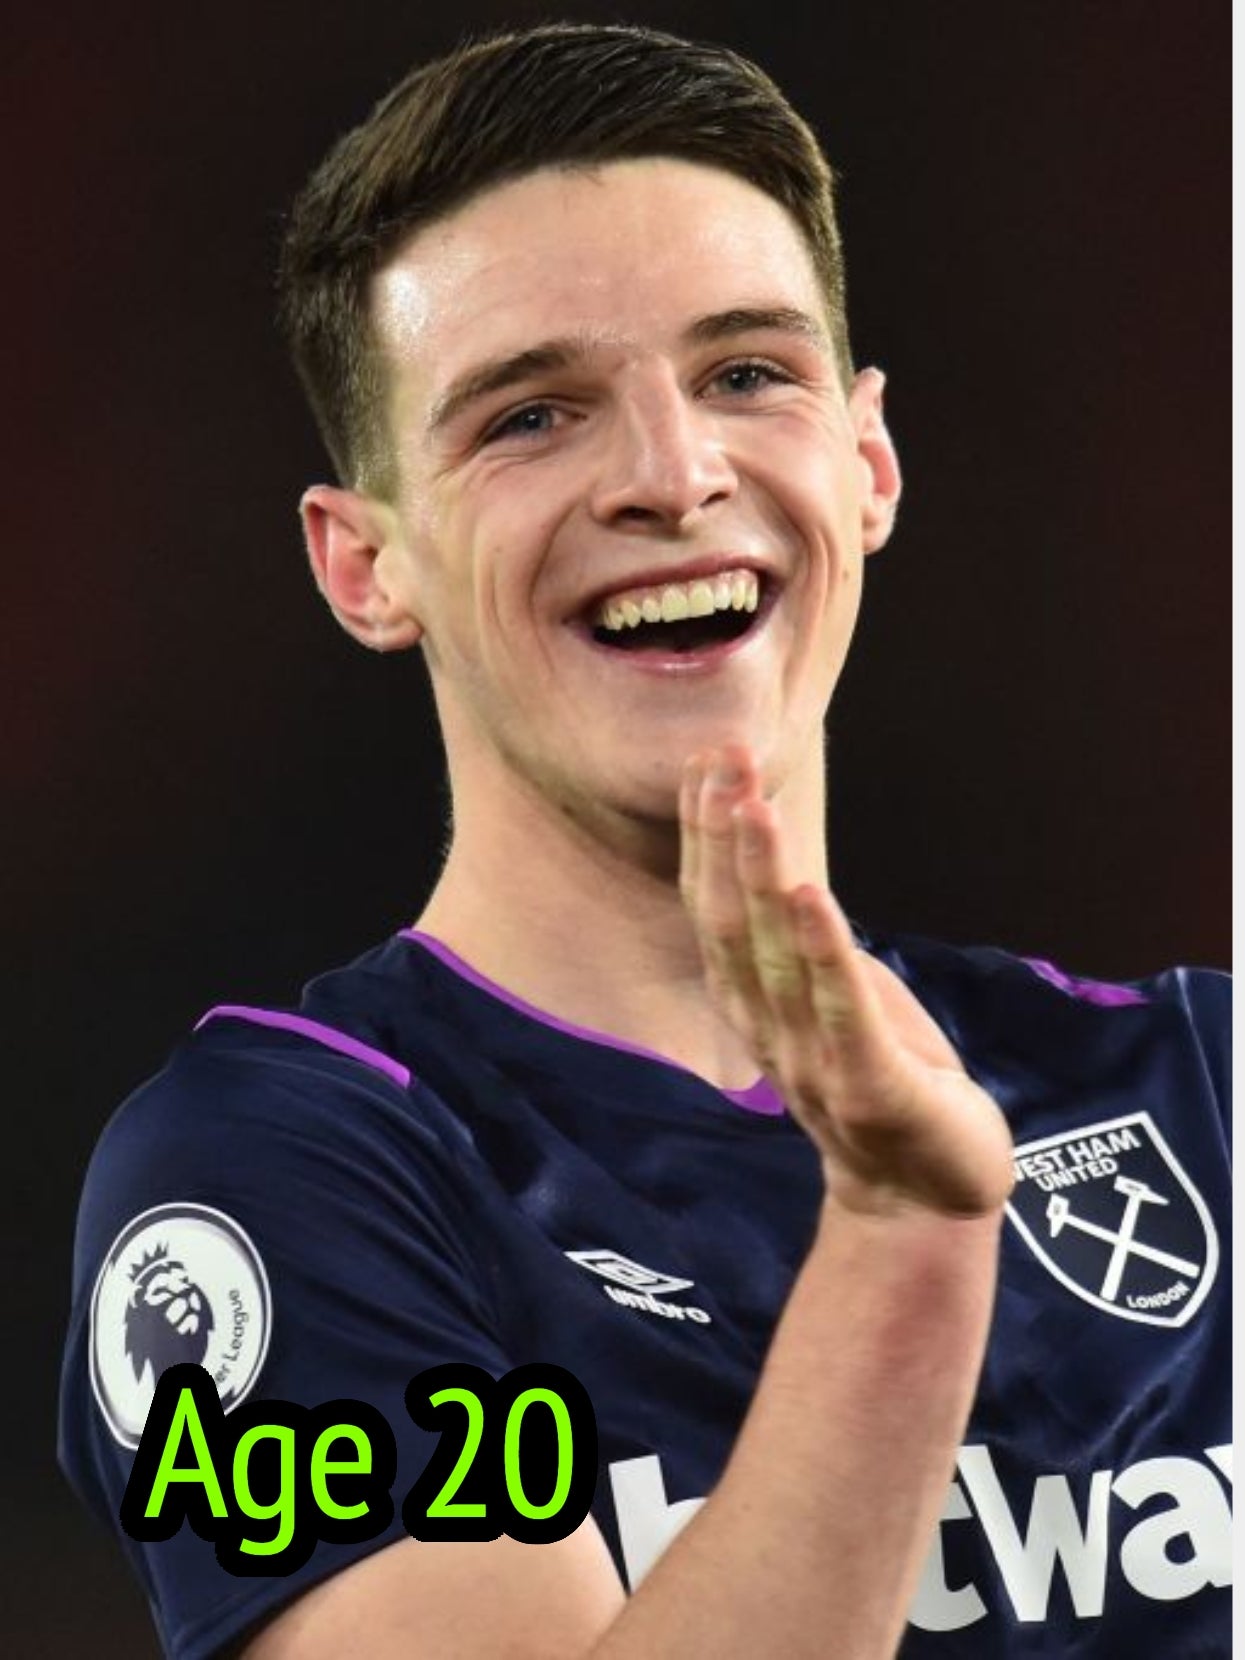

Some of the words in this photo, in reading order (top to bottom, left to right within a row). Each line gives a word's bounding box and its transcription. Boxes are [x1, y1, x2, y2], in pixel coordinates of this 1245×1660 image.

[1065, 1127, 1141, 1167] HAM
[1035, 1156, 1118, 1193] UNITED
[1125, 1280, 1190, 1309] LONDON
[221, 1289, 250, 1362] League
